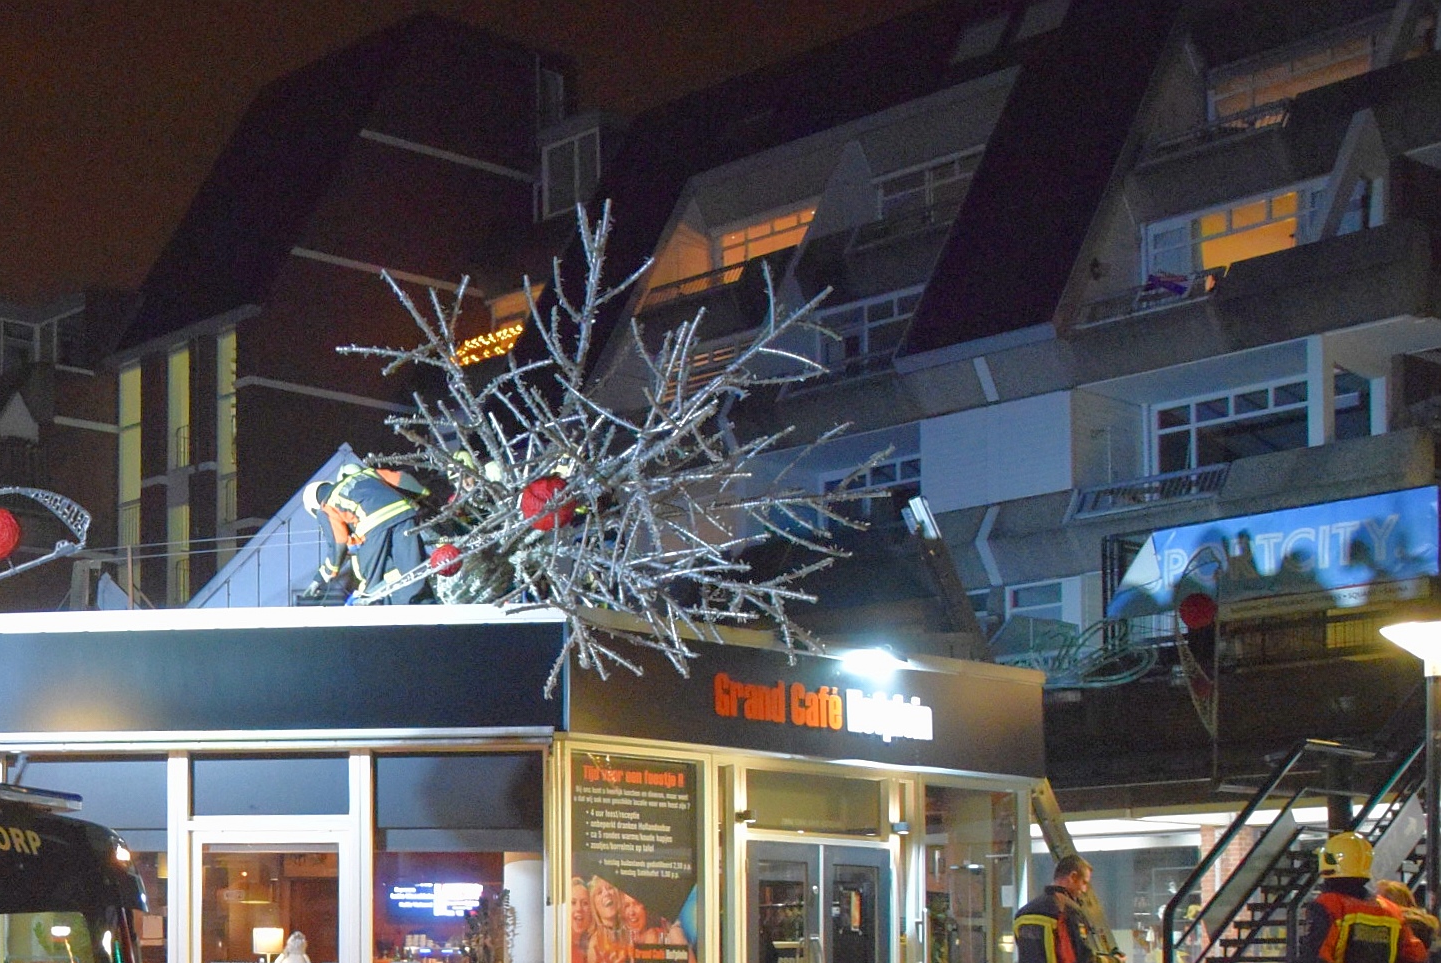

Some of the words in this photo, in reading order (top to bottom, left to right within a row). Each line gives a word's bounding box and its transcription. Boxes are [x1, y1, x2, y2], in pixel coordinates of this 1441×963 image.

[1144, 513, 1400, 592] POTCITY
[714, 672, 786, 724] Grand
[790, 682, 843, 731] Café
